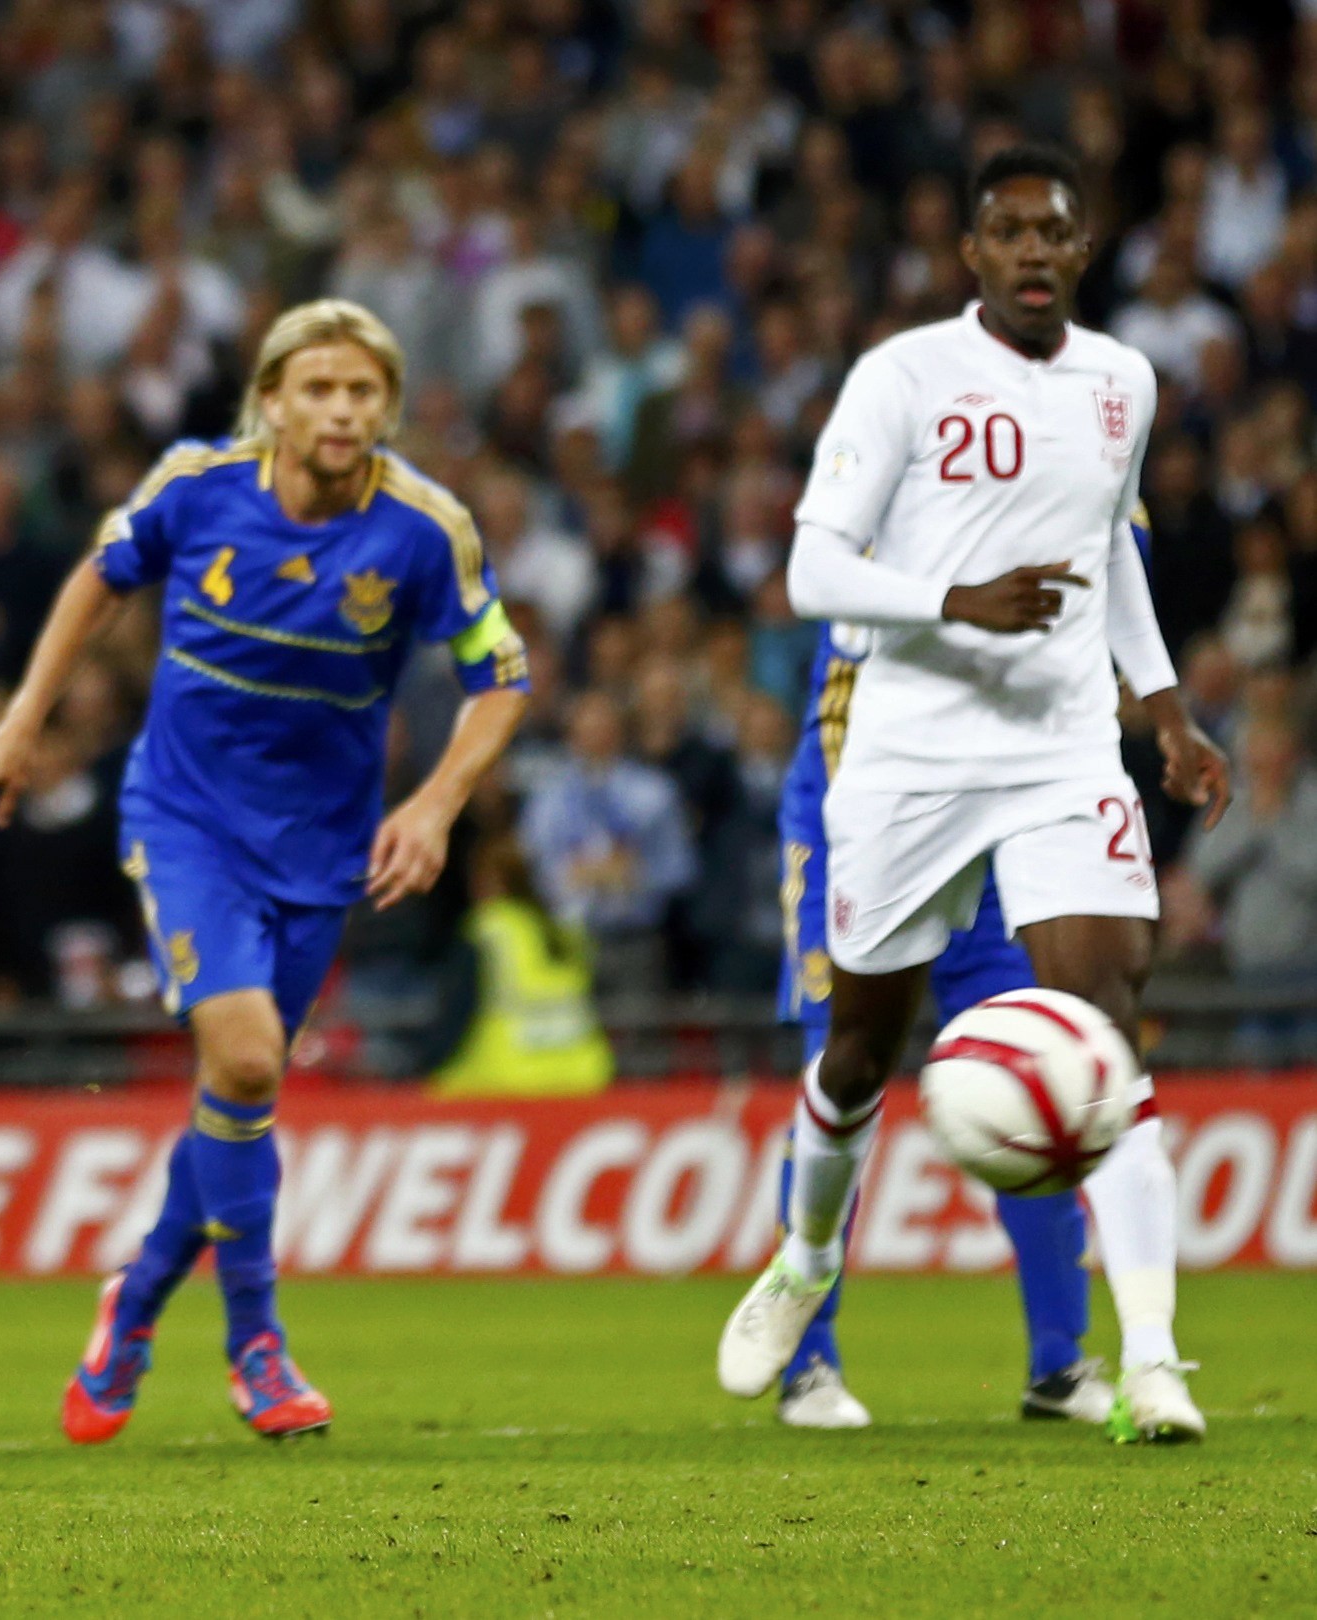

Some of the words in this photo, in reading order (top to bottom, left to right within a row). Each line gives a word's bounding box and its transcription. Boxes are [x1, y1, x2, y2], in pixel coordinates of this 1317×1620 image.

[937, 412, 1025, 482] 20
[200, 546, 236, 607] 4
[272, 1124, 1015, 1270] WELCOE
[1162, 1114, 1317, 1267] OU
